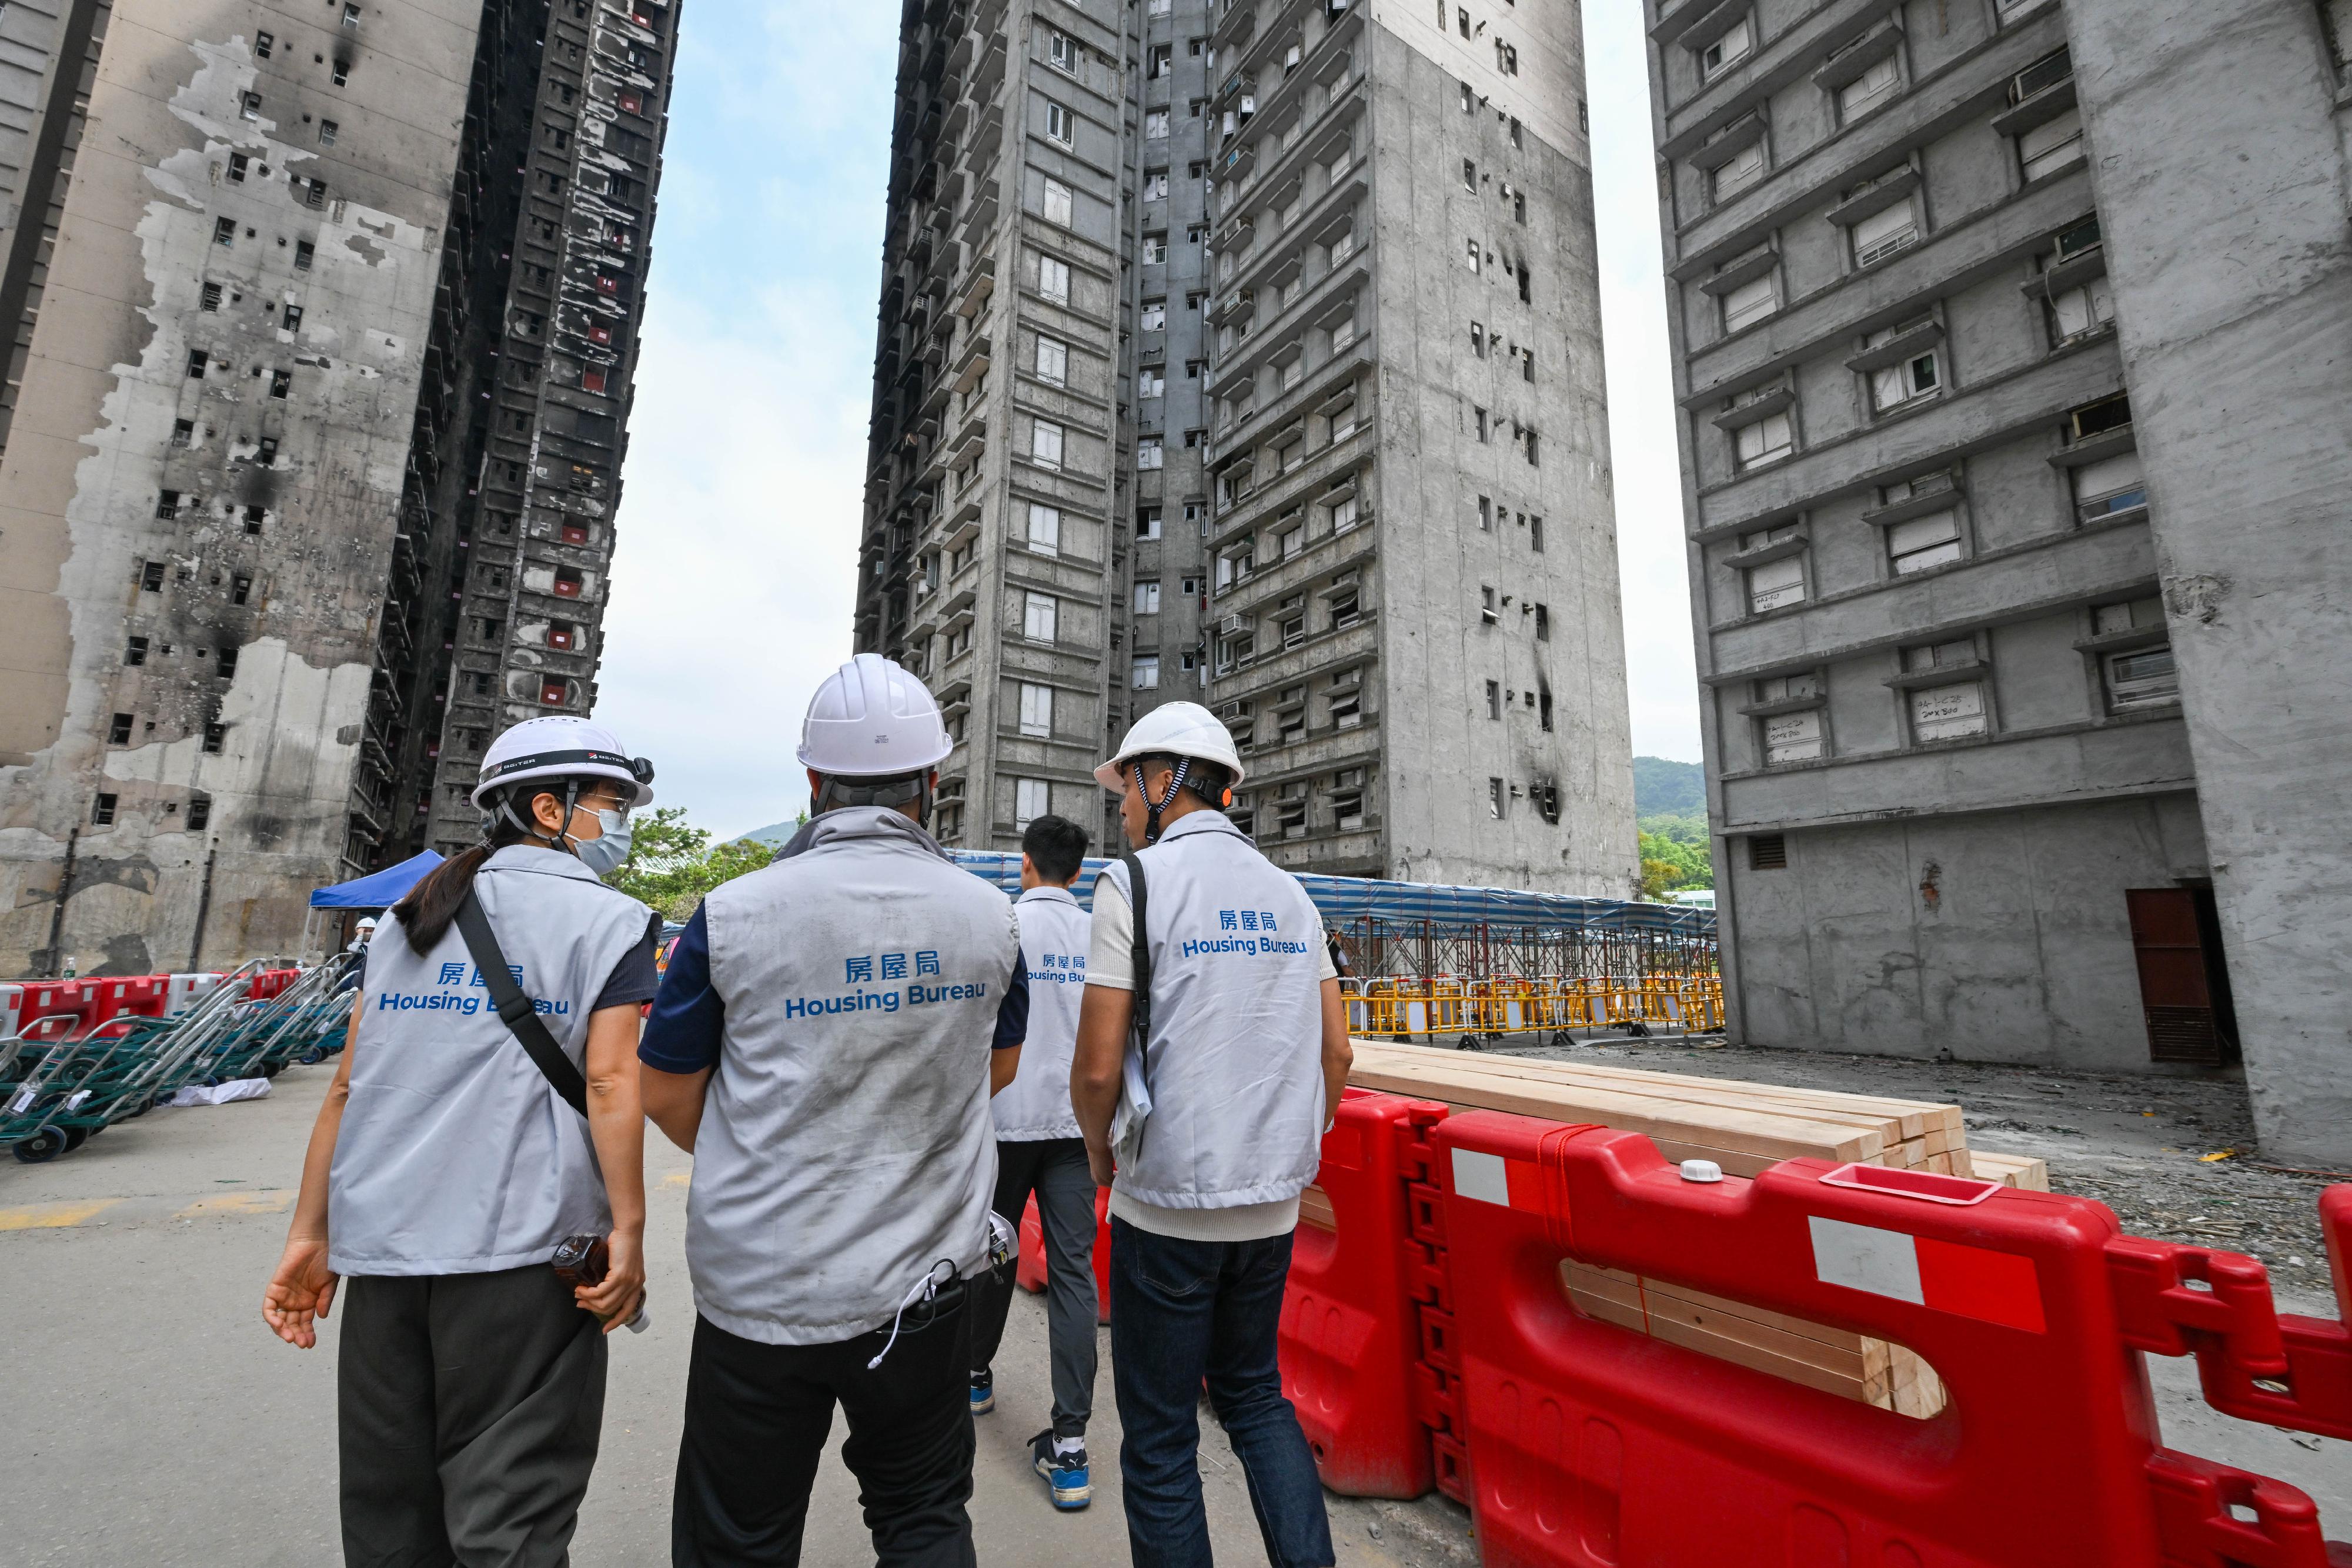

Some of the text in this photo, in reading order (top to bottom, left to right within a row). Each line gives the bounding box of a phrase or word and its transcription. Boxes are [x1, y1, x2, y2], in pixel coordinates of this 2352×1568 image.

[1220, 910, 1277, 931] 房屋局
[1182, 935, 1307, 958] Housing Bureau
[846, 950, 940, 984] 房屋局
[1043, 954, 1085, 969] 房屋局
[1028, 969, 1065, 984] ousing
[379, 990, 480, 1015] Housing
[786, 983, 985, 1019] Housing Bureau
